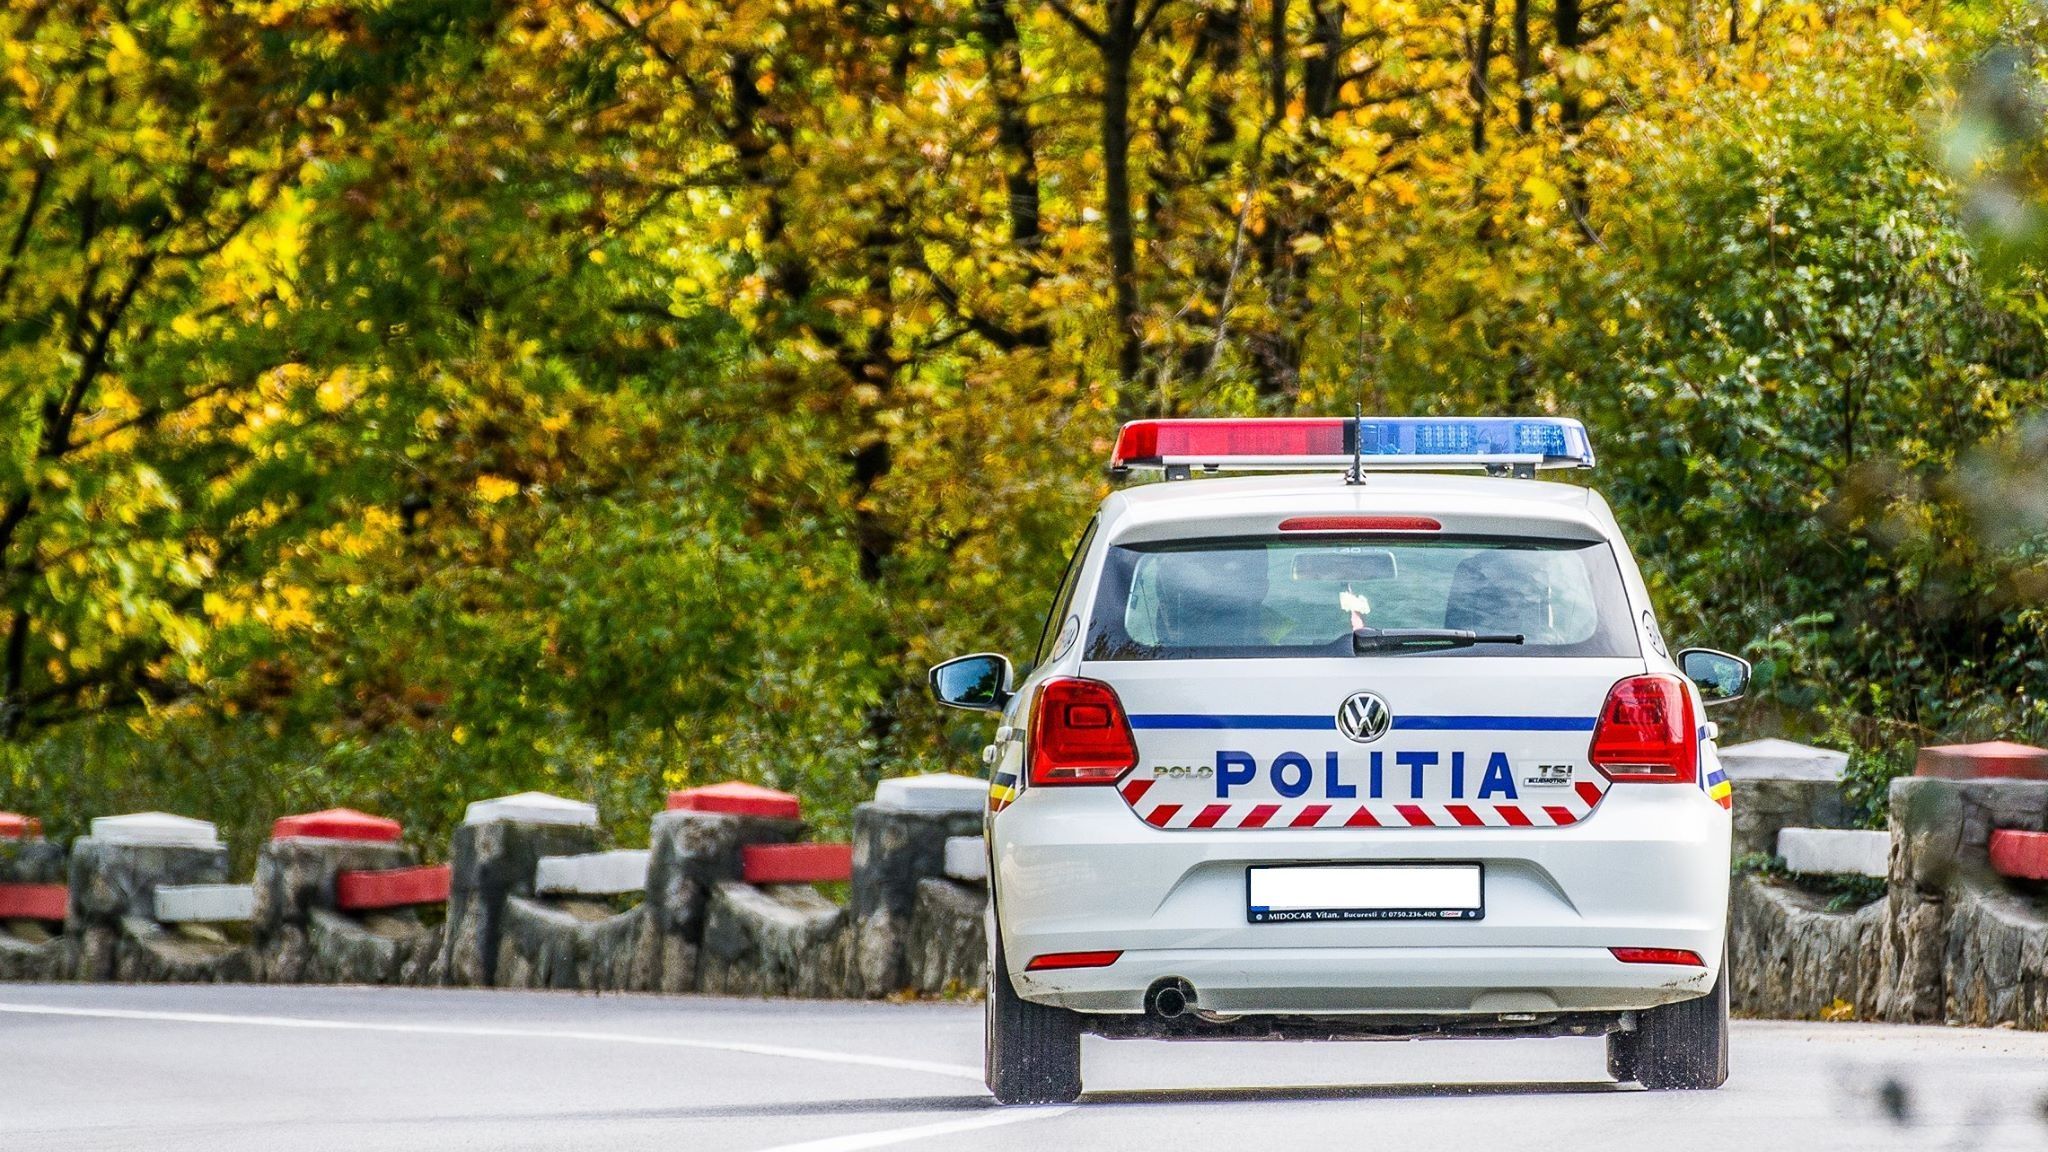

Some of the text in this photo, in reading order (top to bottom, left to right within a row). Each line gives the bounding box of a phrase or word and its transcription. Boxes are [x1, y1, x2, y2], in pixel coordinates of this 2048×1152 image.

[1339, 692, 1389, 741] VW
[1153, 766, 1213, 779] POLO
[1216, 751, 1518, 799] POLITIA
[1538, 765, 1573, 777] TSI
[1268, 912, 1312, 920] MIDOCAR
